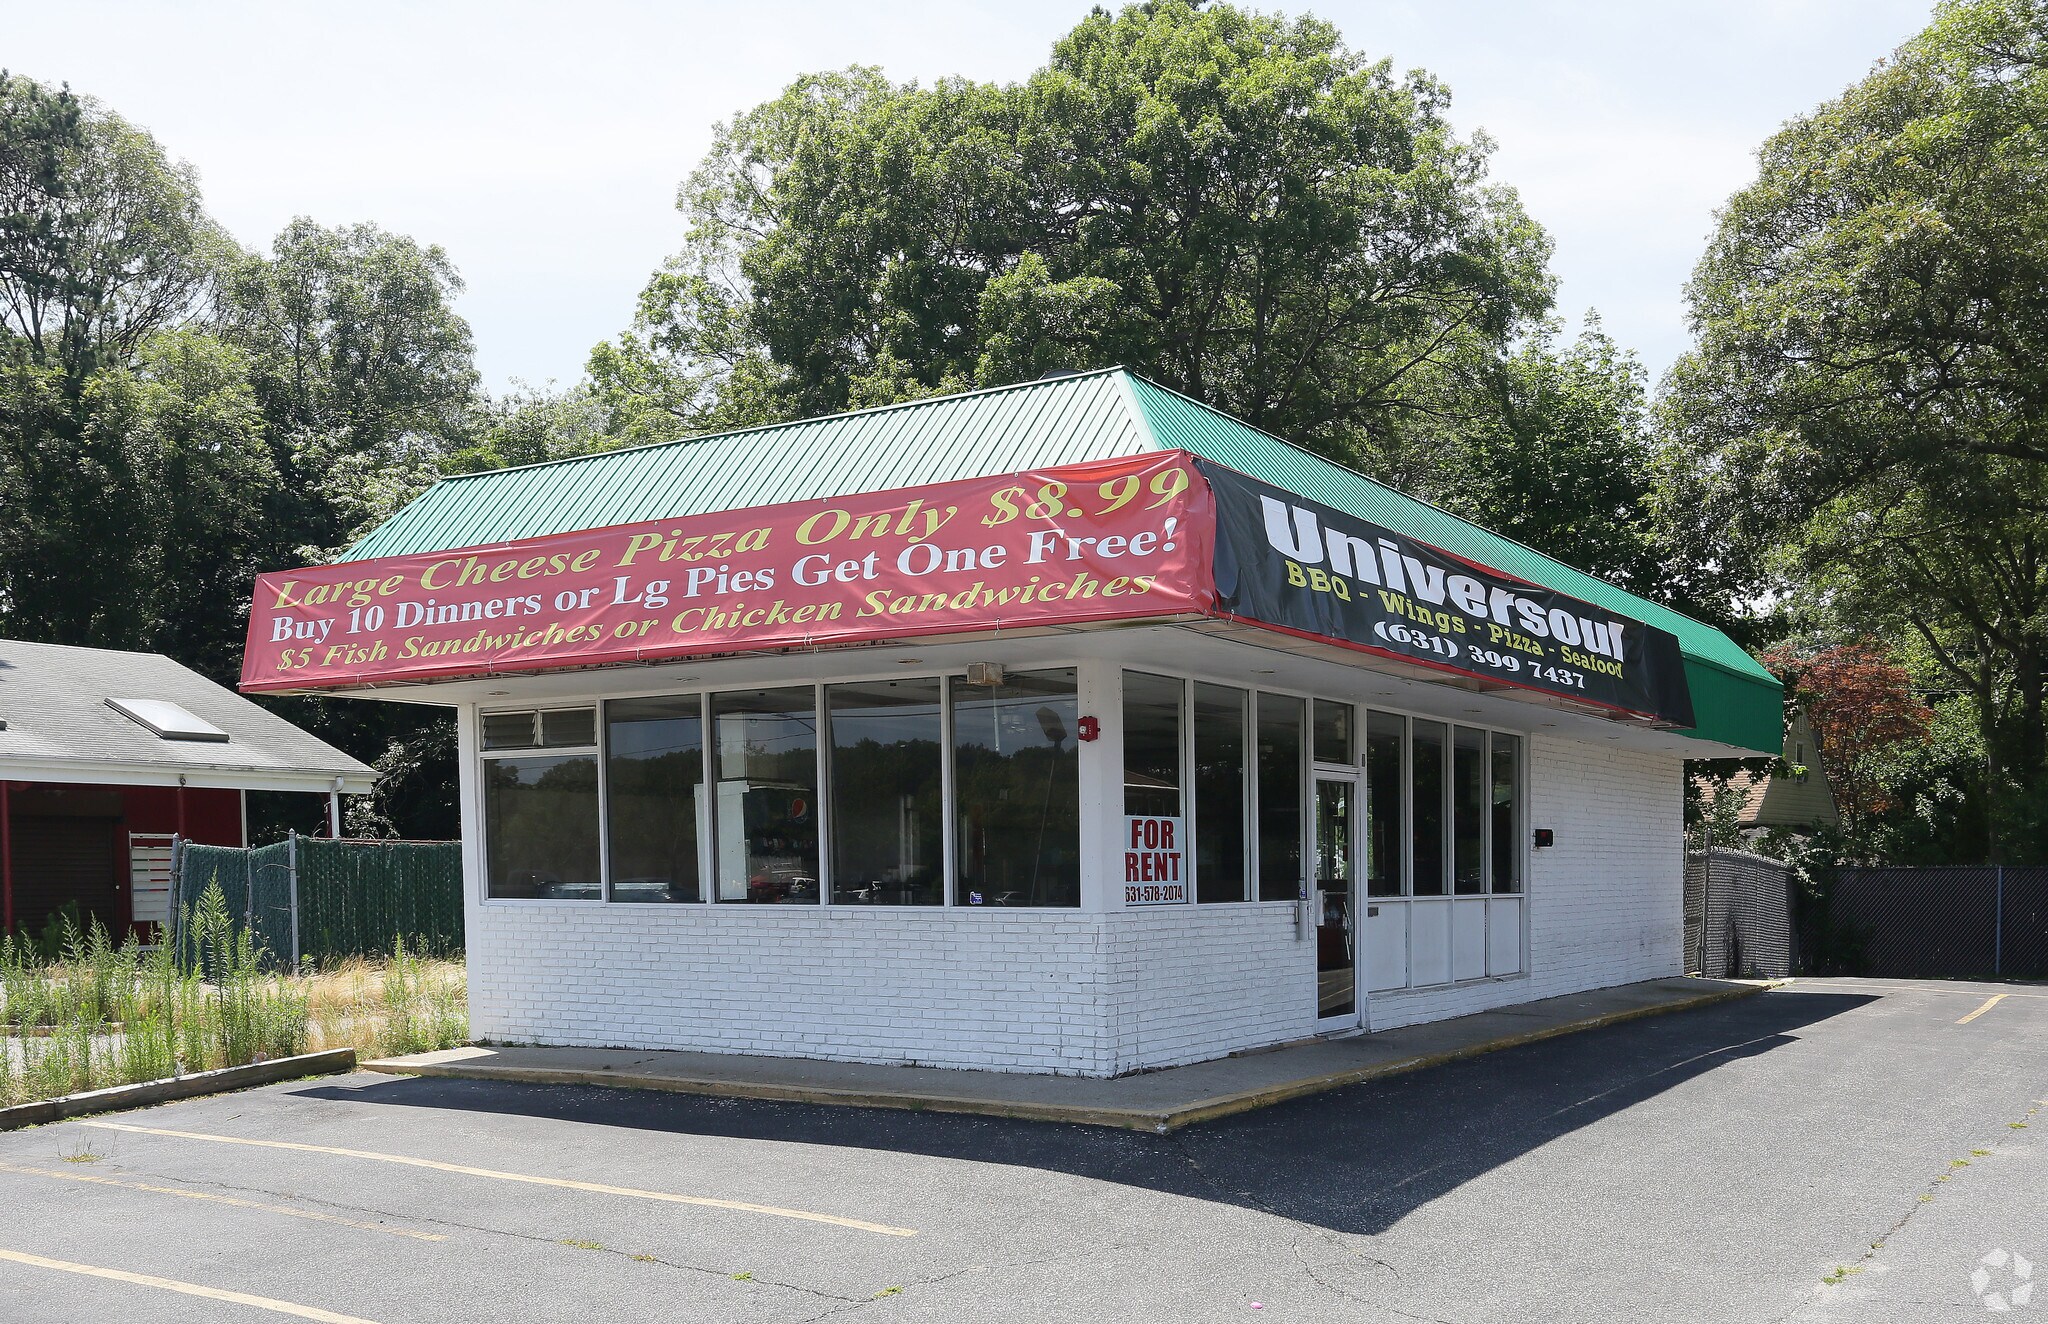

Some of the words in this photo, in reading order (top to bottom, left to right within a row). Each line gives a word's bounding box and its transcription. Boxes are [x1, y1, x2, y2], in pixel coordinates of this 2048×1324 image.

[269, 615, 335, 645] Buy
[346, 604, 385, 635] 10
[393, 593, 542, 630] Dinners
[554, 585, 600, 611] or
[609, 575, 671, 610] Lg
[684, 563, 775, 598] Pies
[791, 550, 881, 588] Get
[896, 542, 1007, 577] One
[1023, 517, 1178, 566] Free!
[270, 574, 404, 611] Large
[420, 548, 601, 592] Cheese
[612, 526, 771, 569] Pizza
[795, 499, 958, 544] Only
[981, 467, 1190, 529] $8.99
[1259, 494, 1625, 663] Universoul
[276, 645, 312, 672] $5
[319, 638, 388, 668] Fish
[396, 622, 604, 660] Sandwiches
[613, 616, 659, 639] or
[671, 598, 842, 635] Chicken
[855, 571, 1158, 619] Sandwiches
[1285, 559, 1352, 602] BBQ
[1377, 589, 1467, 635] Wings
[1490, 622, 1545, 657] Pizza
[1560, 645, 1624, 680] Seafood
[1373, 621, 1460, 660] (631)
[1468, 643, 1522, 673] 399
[1527, 660, 1586, 690] 7437
[1125, 852, 1181, 882] RENT
[1131, 819, 1174, 849] FOR
[1125, 885, 1183, 902] 631-578-2074
